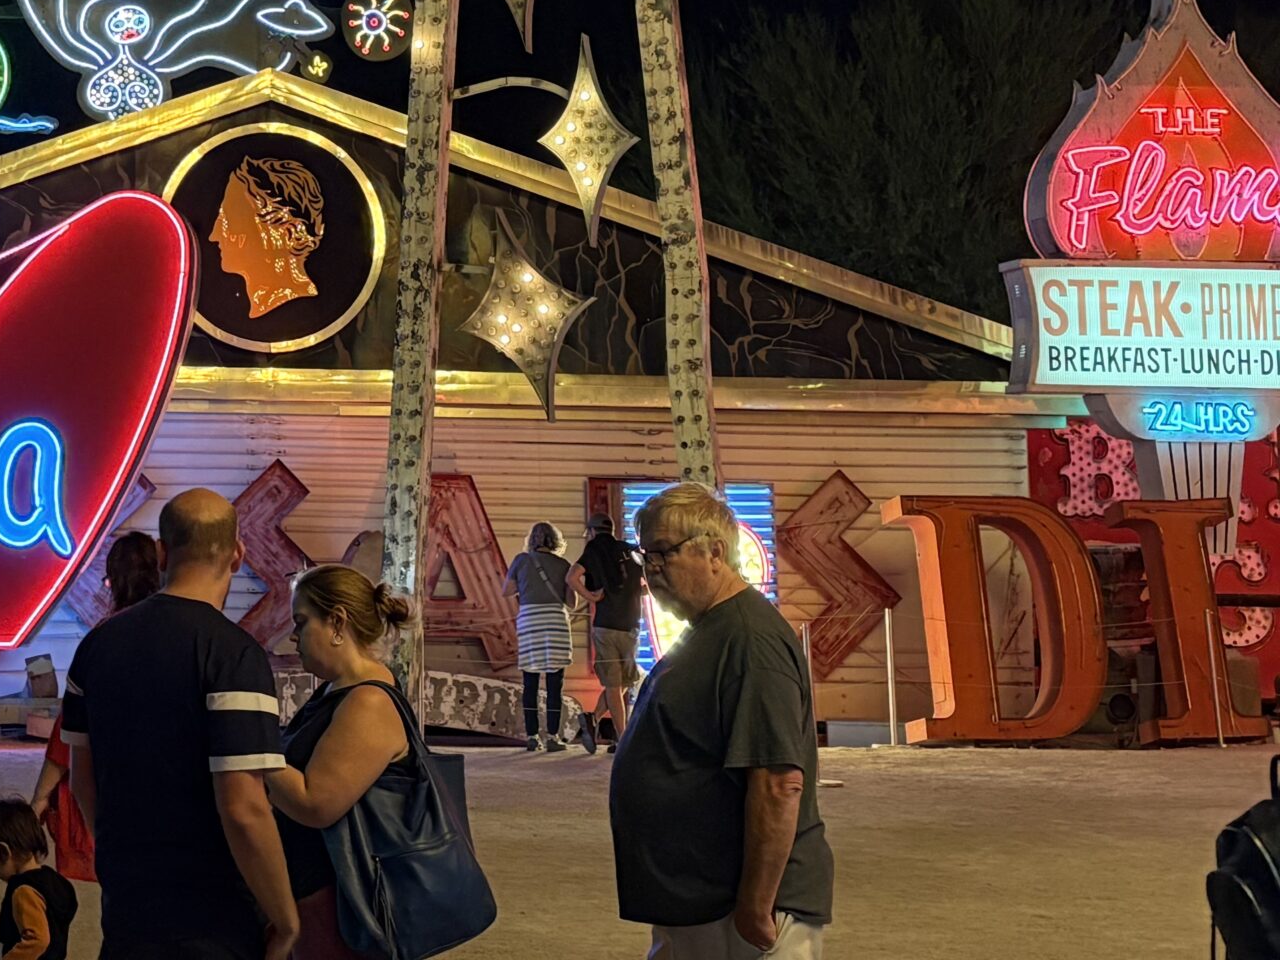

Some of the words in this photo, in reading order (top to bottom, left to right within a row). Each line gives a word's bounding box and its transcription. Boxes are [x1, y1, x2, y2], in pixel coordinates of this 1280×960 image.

[1140, 107, 1229, 135] THE
[1063, 140, 1280, 249] Flam
[1042, 279, 1184, 338] STEAK
[1142, 401, 1184, 432] 24
[1195, 402, 1255, 434] HRS
